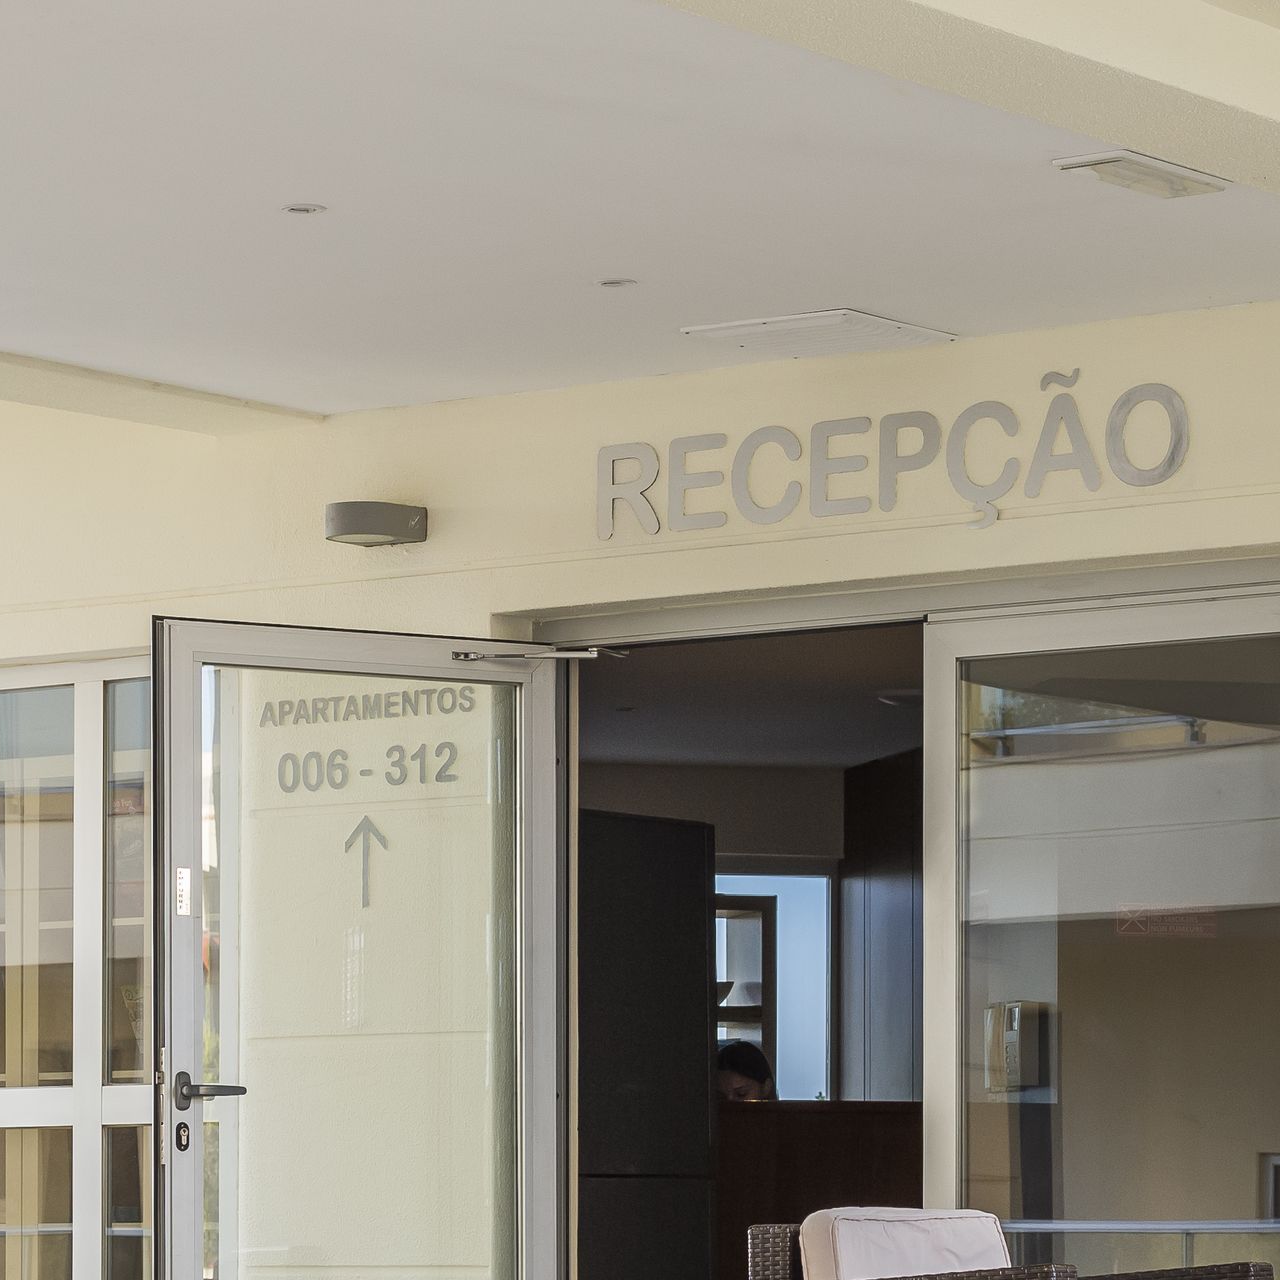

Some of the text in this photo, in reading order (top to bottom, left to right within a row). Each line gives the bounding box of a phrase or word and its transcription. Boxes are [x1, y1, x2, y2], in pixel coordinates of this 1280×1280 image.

[597, 367, 1191, 541] RECEPÇÃO
[259, 686, 476, 728] APARTAMENTOS
[277, 749, 349, 793] 006
[384, 741, 459, 786] 312
